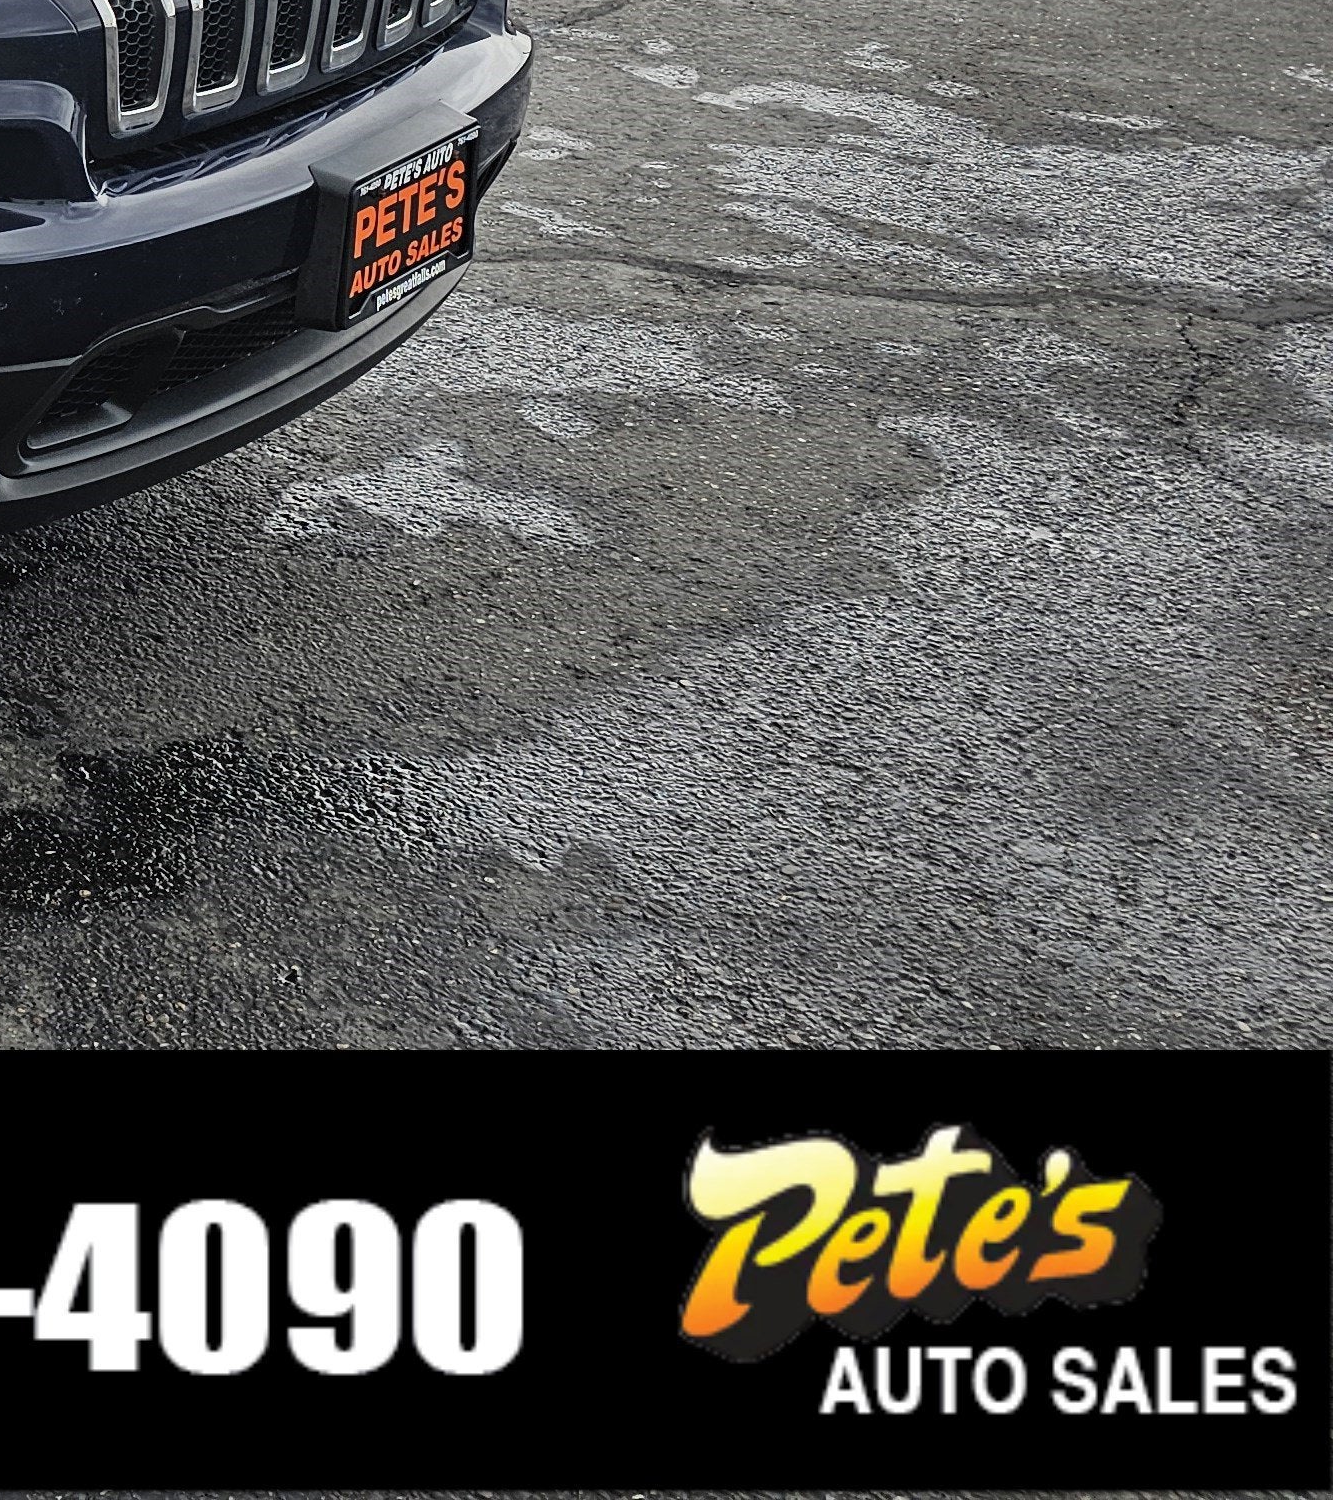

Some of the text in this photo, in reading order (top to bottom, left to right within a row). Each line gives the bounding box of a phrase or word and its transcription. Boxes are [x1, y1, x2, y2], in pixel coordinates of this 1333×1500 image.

[383, 157, 423, 192] PETE'S
[422, 142, 454, 175] AUTO
[353, 159, 466, 259] PETE'S
[348, 216, 464, 299] AUTO SALES
[376, 259, 446, 312] petesgreatfalls.com
